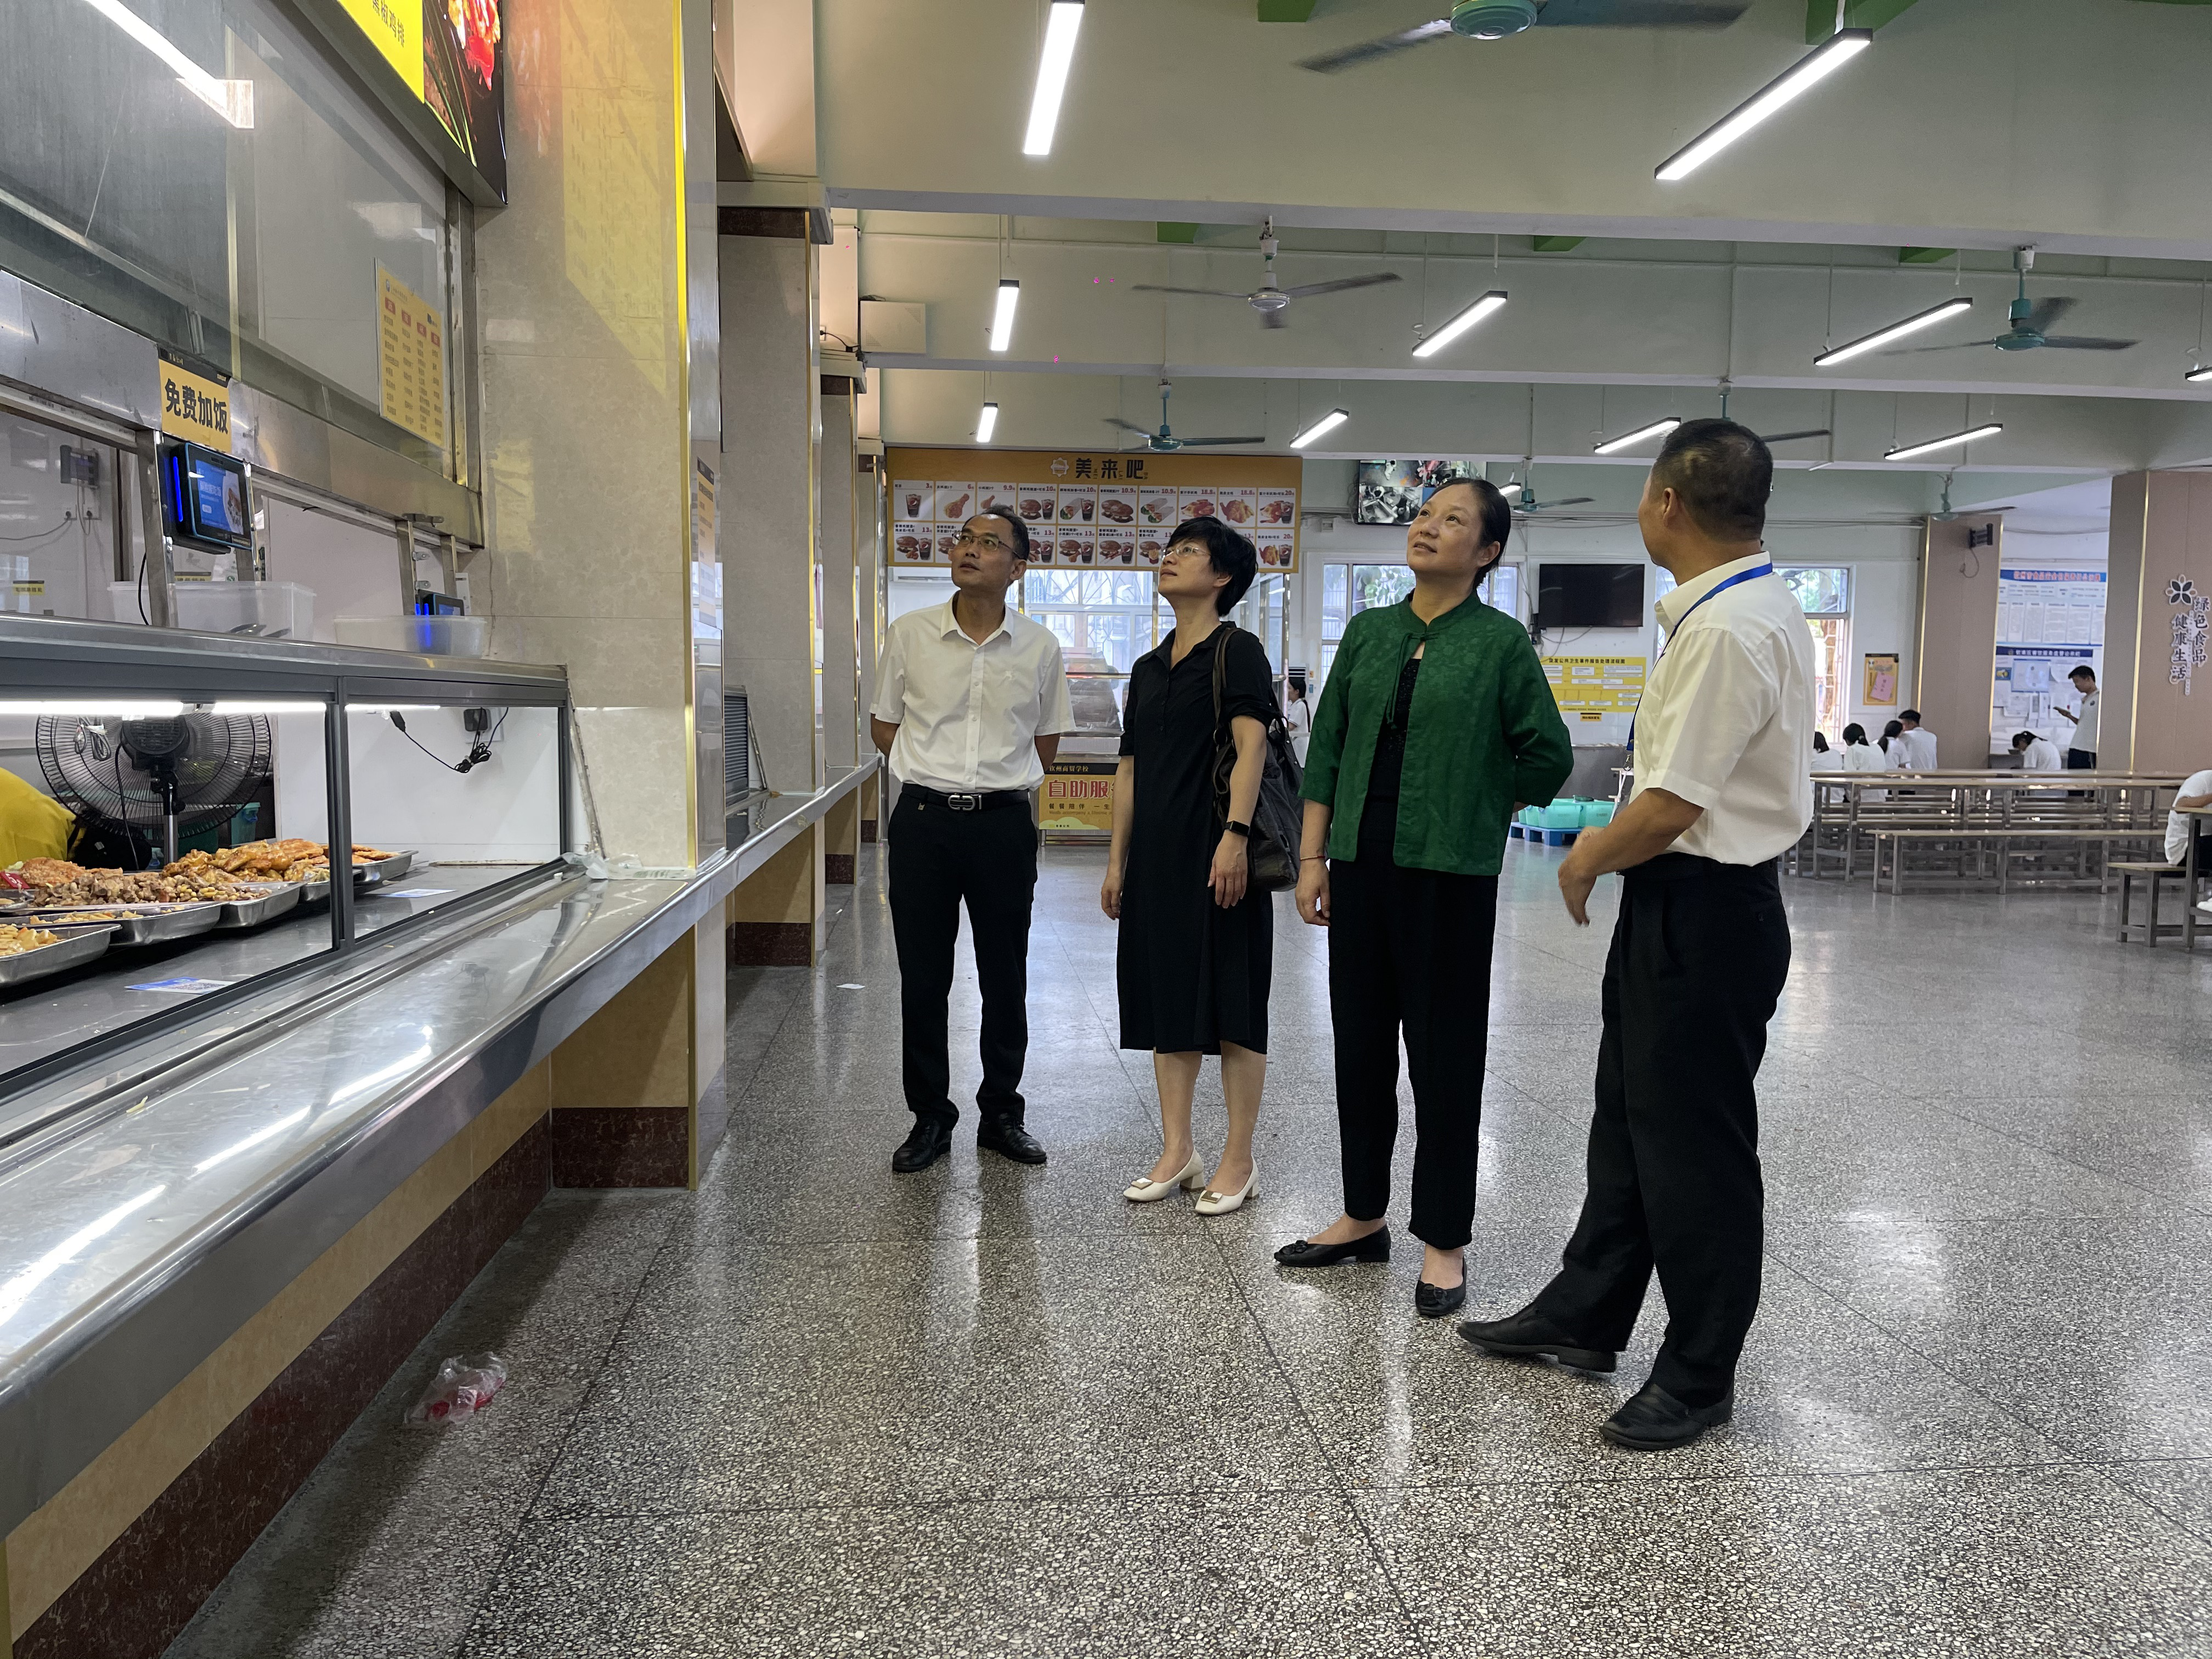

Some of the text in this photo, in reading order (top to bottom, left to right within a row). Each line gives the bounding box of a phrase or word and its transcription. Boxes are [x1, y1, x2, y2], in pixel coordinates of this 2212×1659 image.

[165, 378, 228, 435] 免费加饭
[1076, 458, 1143, 479] 美来吧
[2172, 614, 2188, 679] 健康生活
[2193, 597, 2209, 663] 绿色食品
[1048, 780, 1115, 799] 自助服
